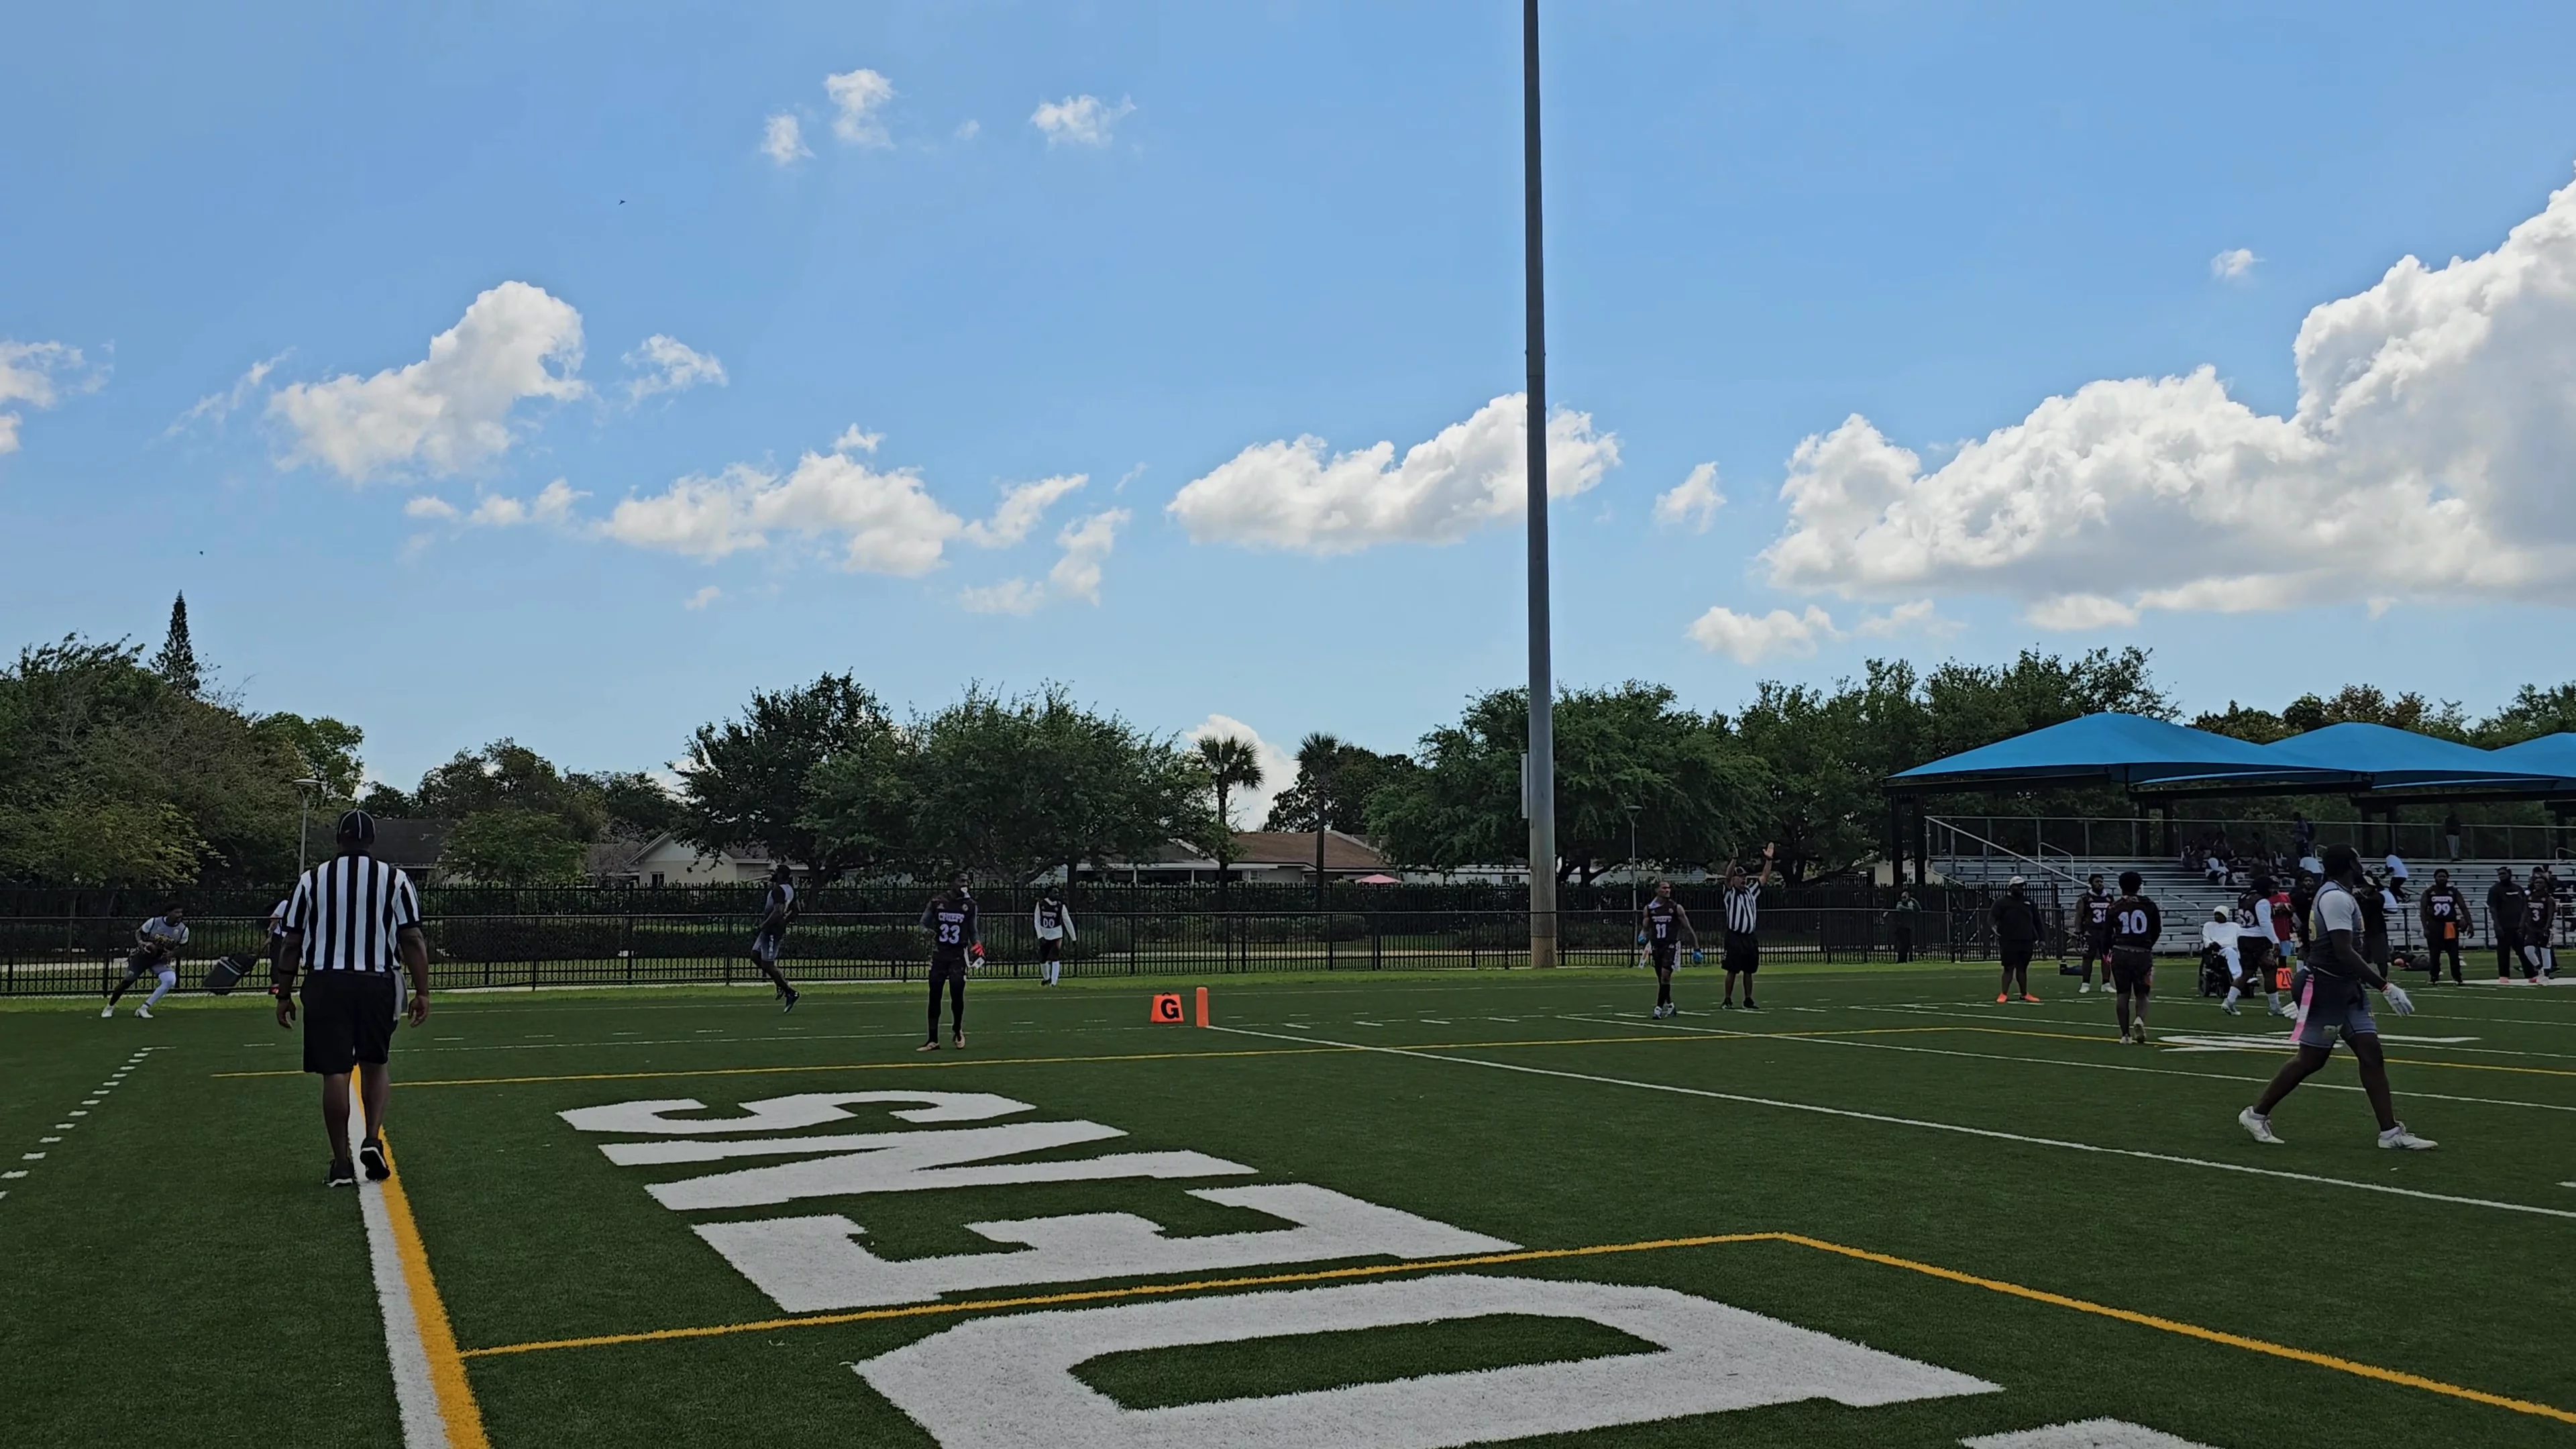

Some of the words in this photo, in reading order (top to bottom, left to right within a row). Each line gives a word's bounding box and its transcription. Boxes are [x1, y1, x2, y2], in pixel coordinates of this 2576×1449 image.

[2433, 902, 2451, 916] 99
[2532, 909, 2540, 922] 3
[1042, 917, 1055, 928] 00
[1655, 923, 1666, 939] 11
[2117, 909, 2147, 934] 10
[938, 923, 961, 945] 33
[1161, 998, 1179, 1020] G
[555, 1091, 2227, 1449] DENS
